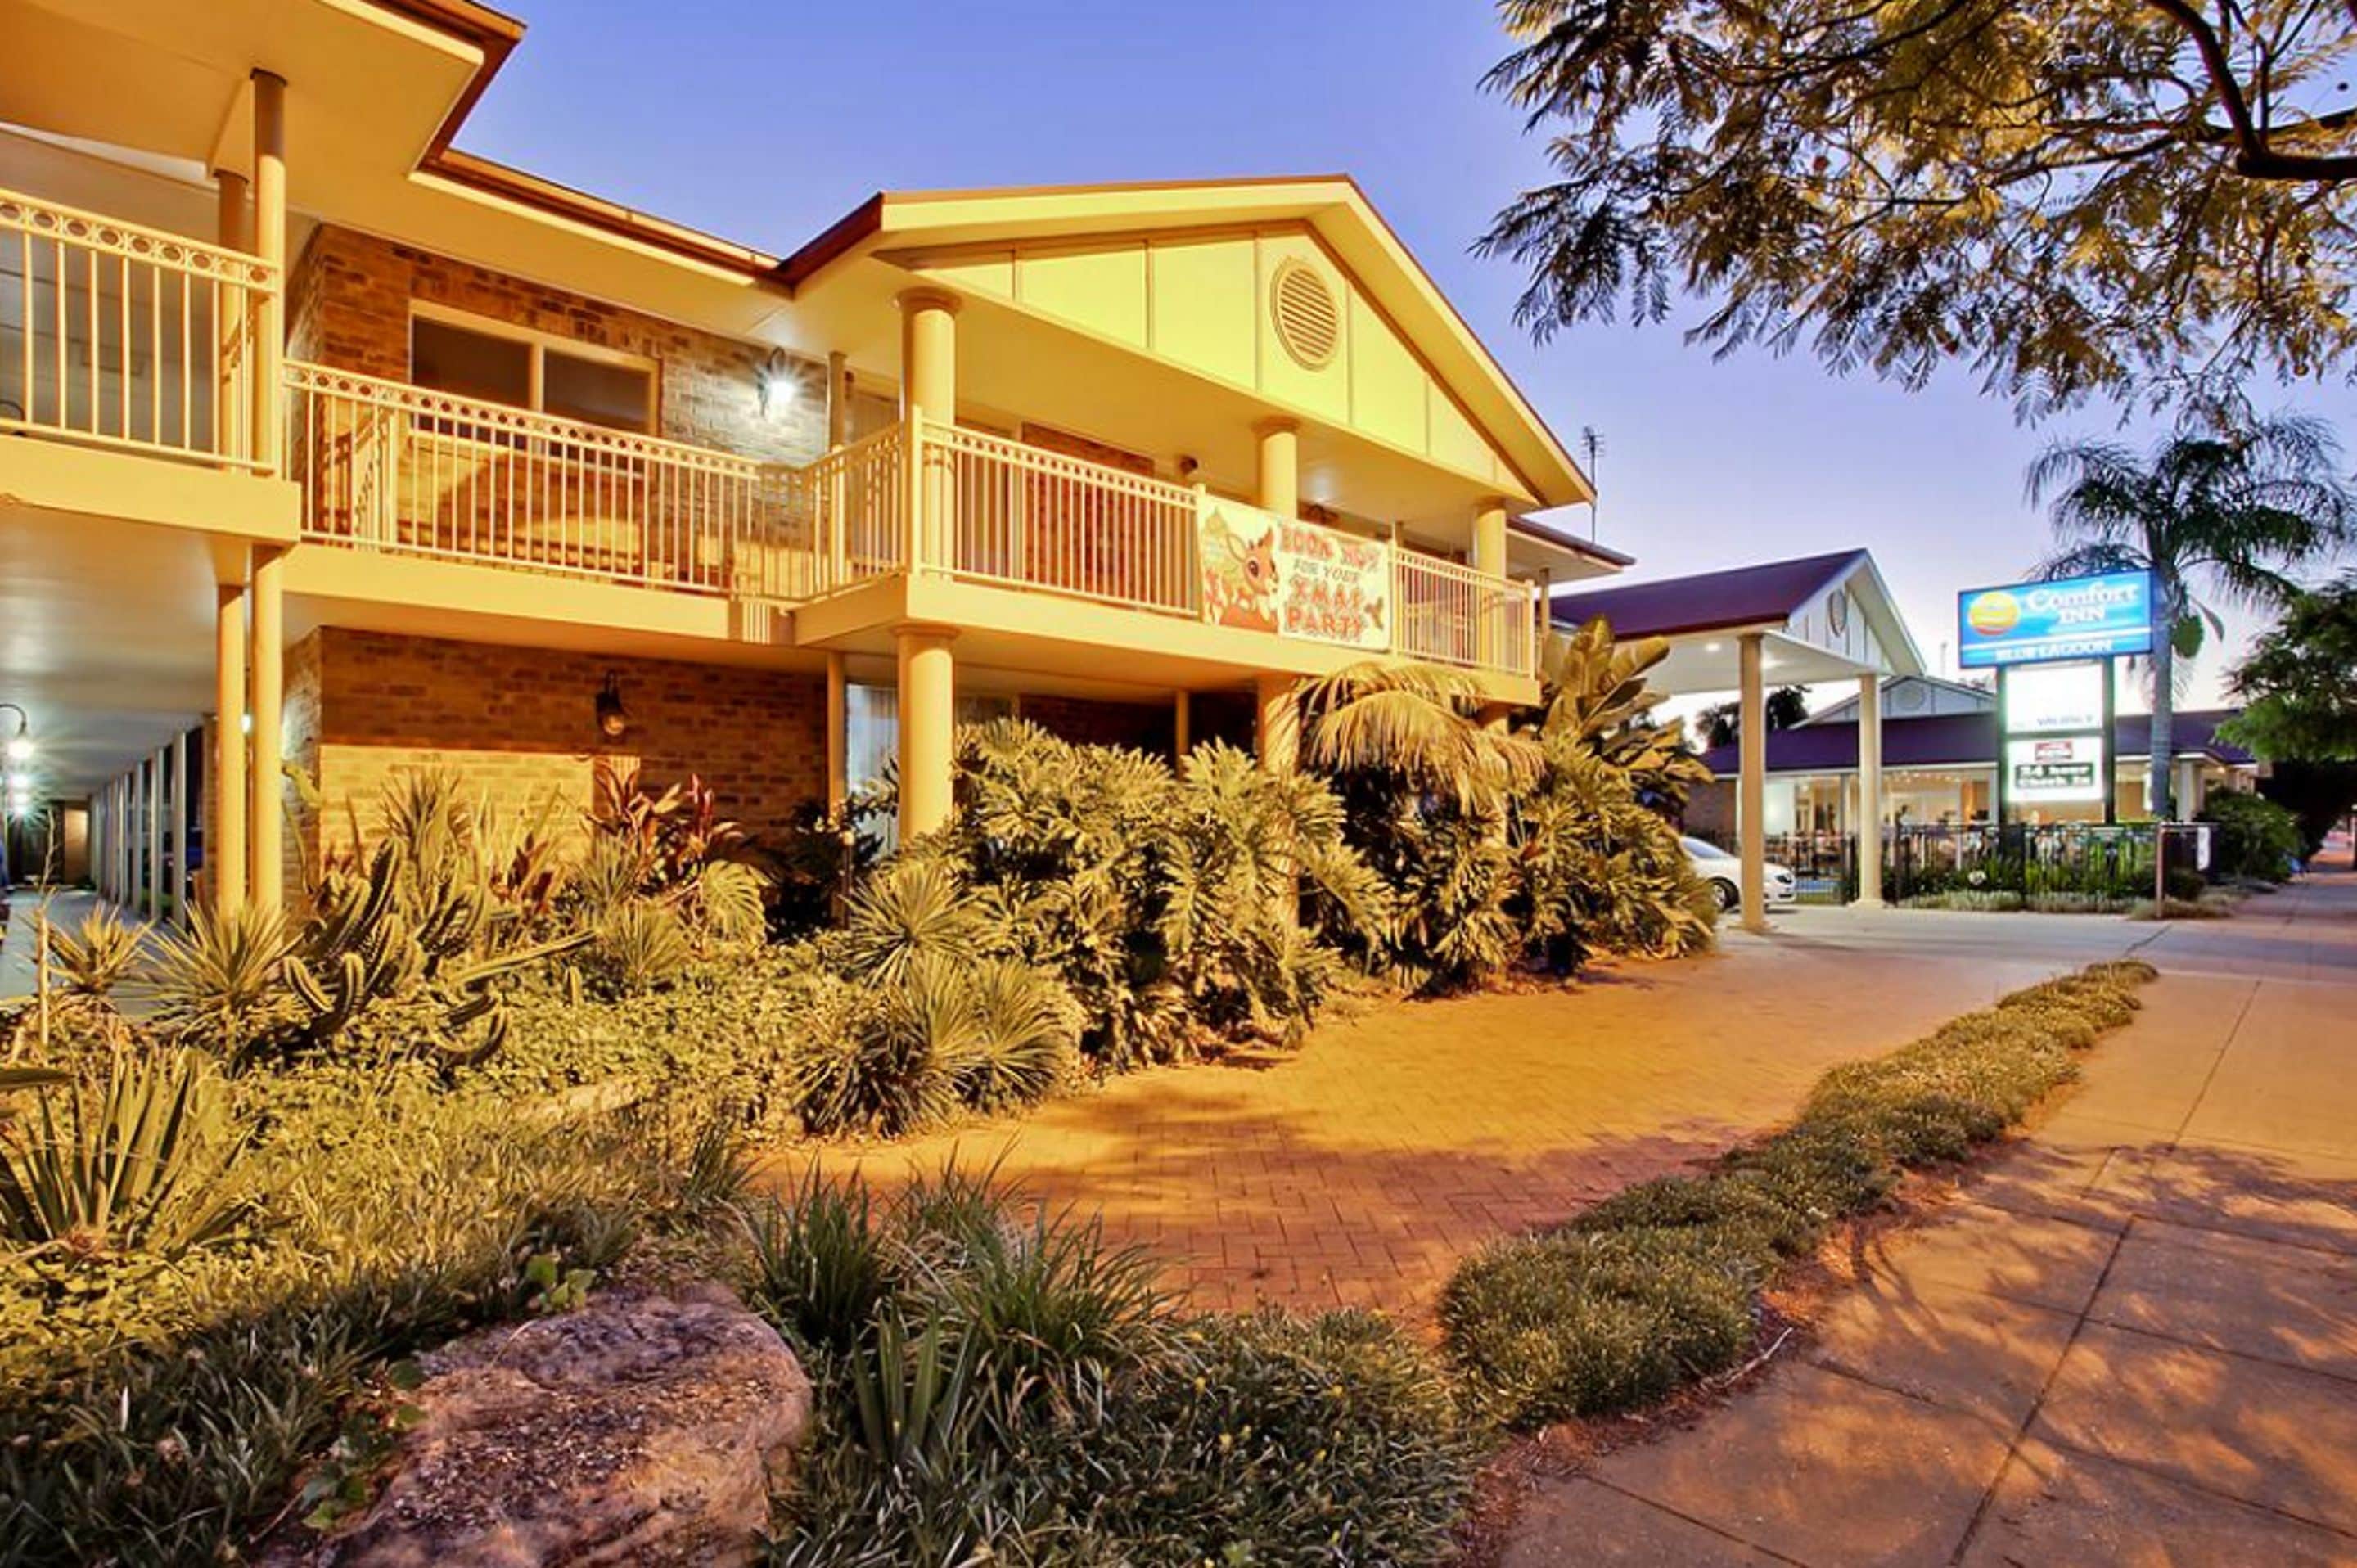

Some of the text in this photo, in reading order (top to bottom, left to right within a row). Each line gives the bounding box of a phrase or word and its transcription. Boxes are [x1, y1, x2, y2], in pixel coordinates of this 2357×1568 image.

[2026, 581, 2139, 611] Comfort
[1284, 602, 1368, 642] PARTY
[2059, 606, 2106, 624] INN
